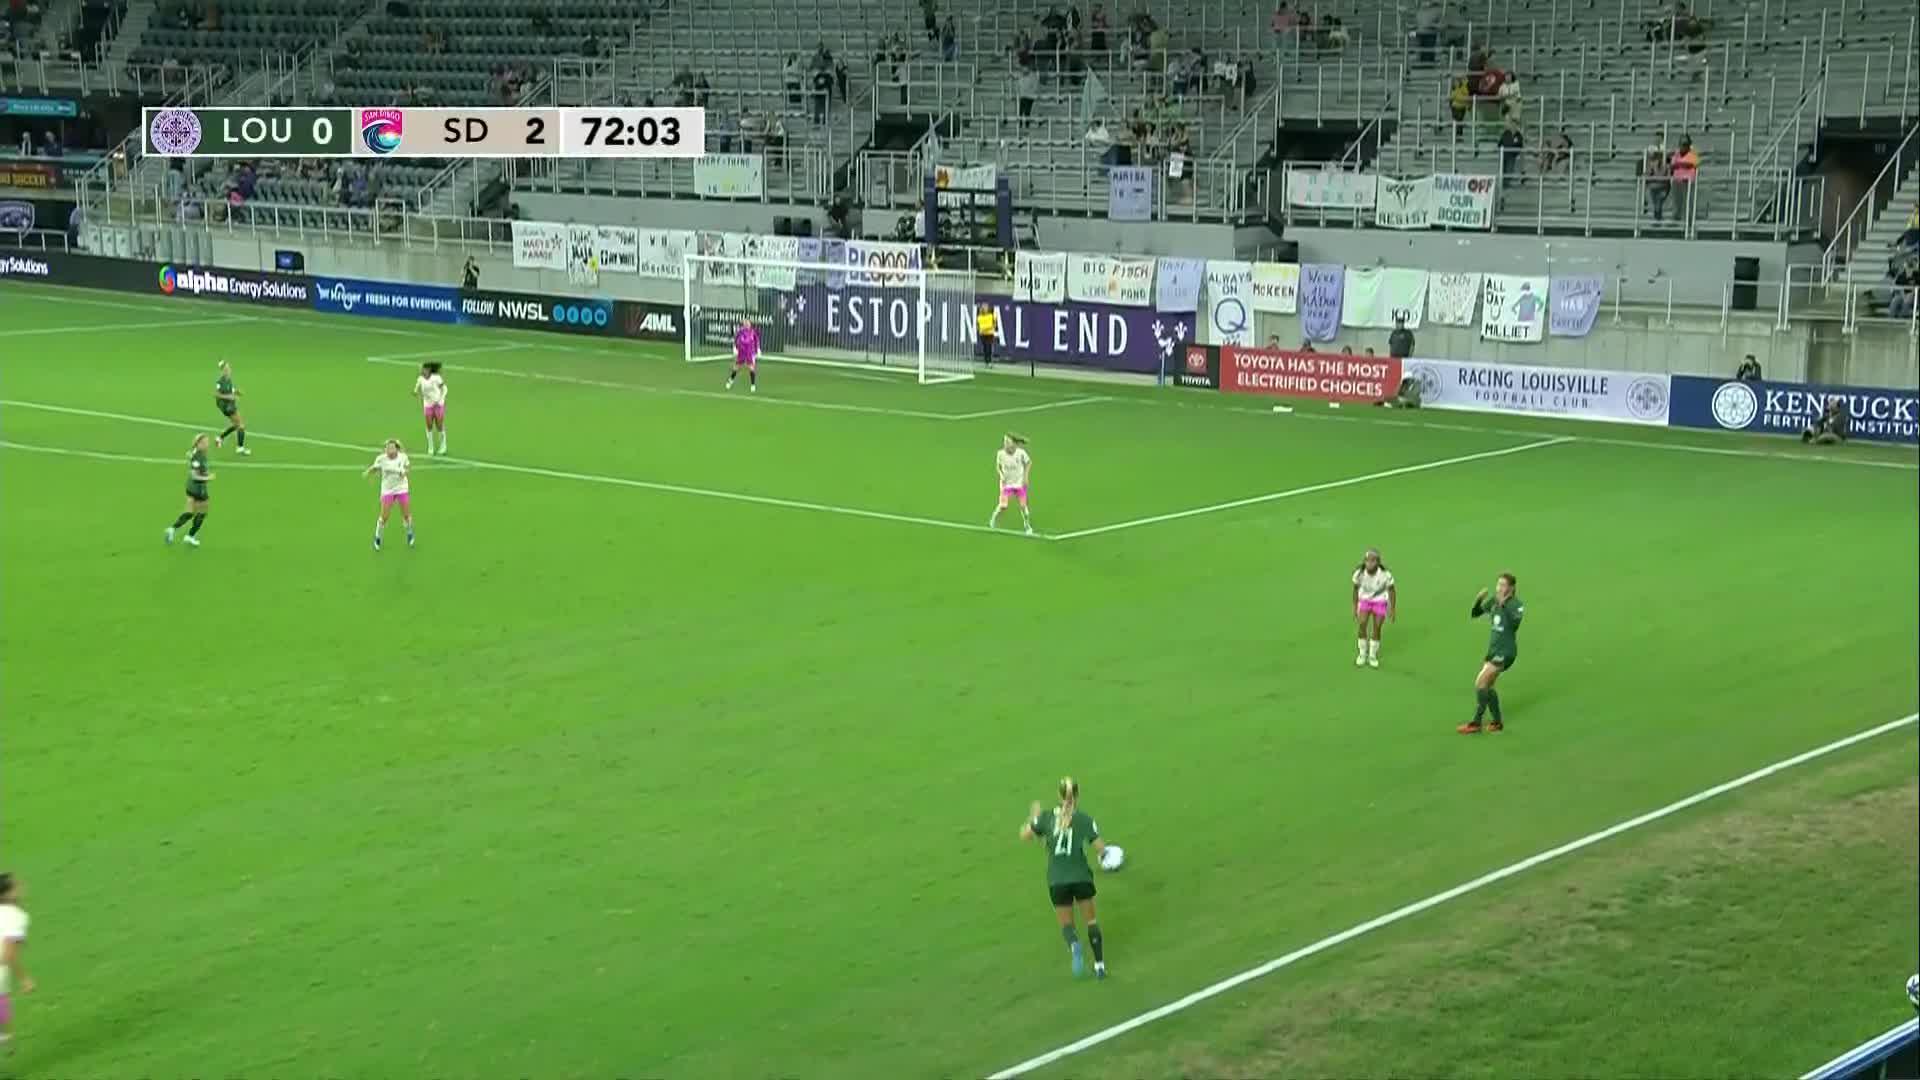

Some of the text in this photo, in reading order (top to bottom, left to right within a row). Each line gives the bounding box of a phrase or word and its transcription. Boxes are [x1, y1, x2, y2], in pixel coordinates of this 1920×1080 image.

[1468, 179, 1492, 194] OFF
[1450, 194, 1473, 208] OUR
[10, 256, 48, 275] Solutions
[176, 269, 307, 299] alpha Energy Solutions
[1209, 271, 1252, 284] ALWAYS
[1486, 278, 1506, 292] ALL
[331, 283, 361, 311] Kroger
[365, 292, 390, 305] FRESH
[391, 294, 408, 308] FOR
[462, 298, 549, 321] FOLLOW NWSL
[1215, 298, 1248, 334] Q
[640, 312, 677, 333] AML
[1054, 309, 1128, 356] END
[1233, 352, 1389, 379] TOYOTA HAS THE MOST
[1181, 375, 1211, 386] TOYOTA
[1237, 371, 1383, 397] ELECTRIFIED CHOICES
[1458, 367, 1609, 396] RACING LOUISVILLE
[1475, 390, 1544, 406] FOOTBALL
[1553, 397, 1589, 410] CLUB
[1764, 389, 1919, 422] KENTUCK
